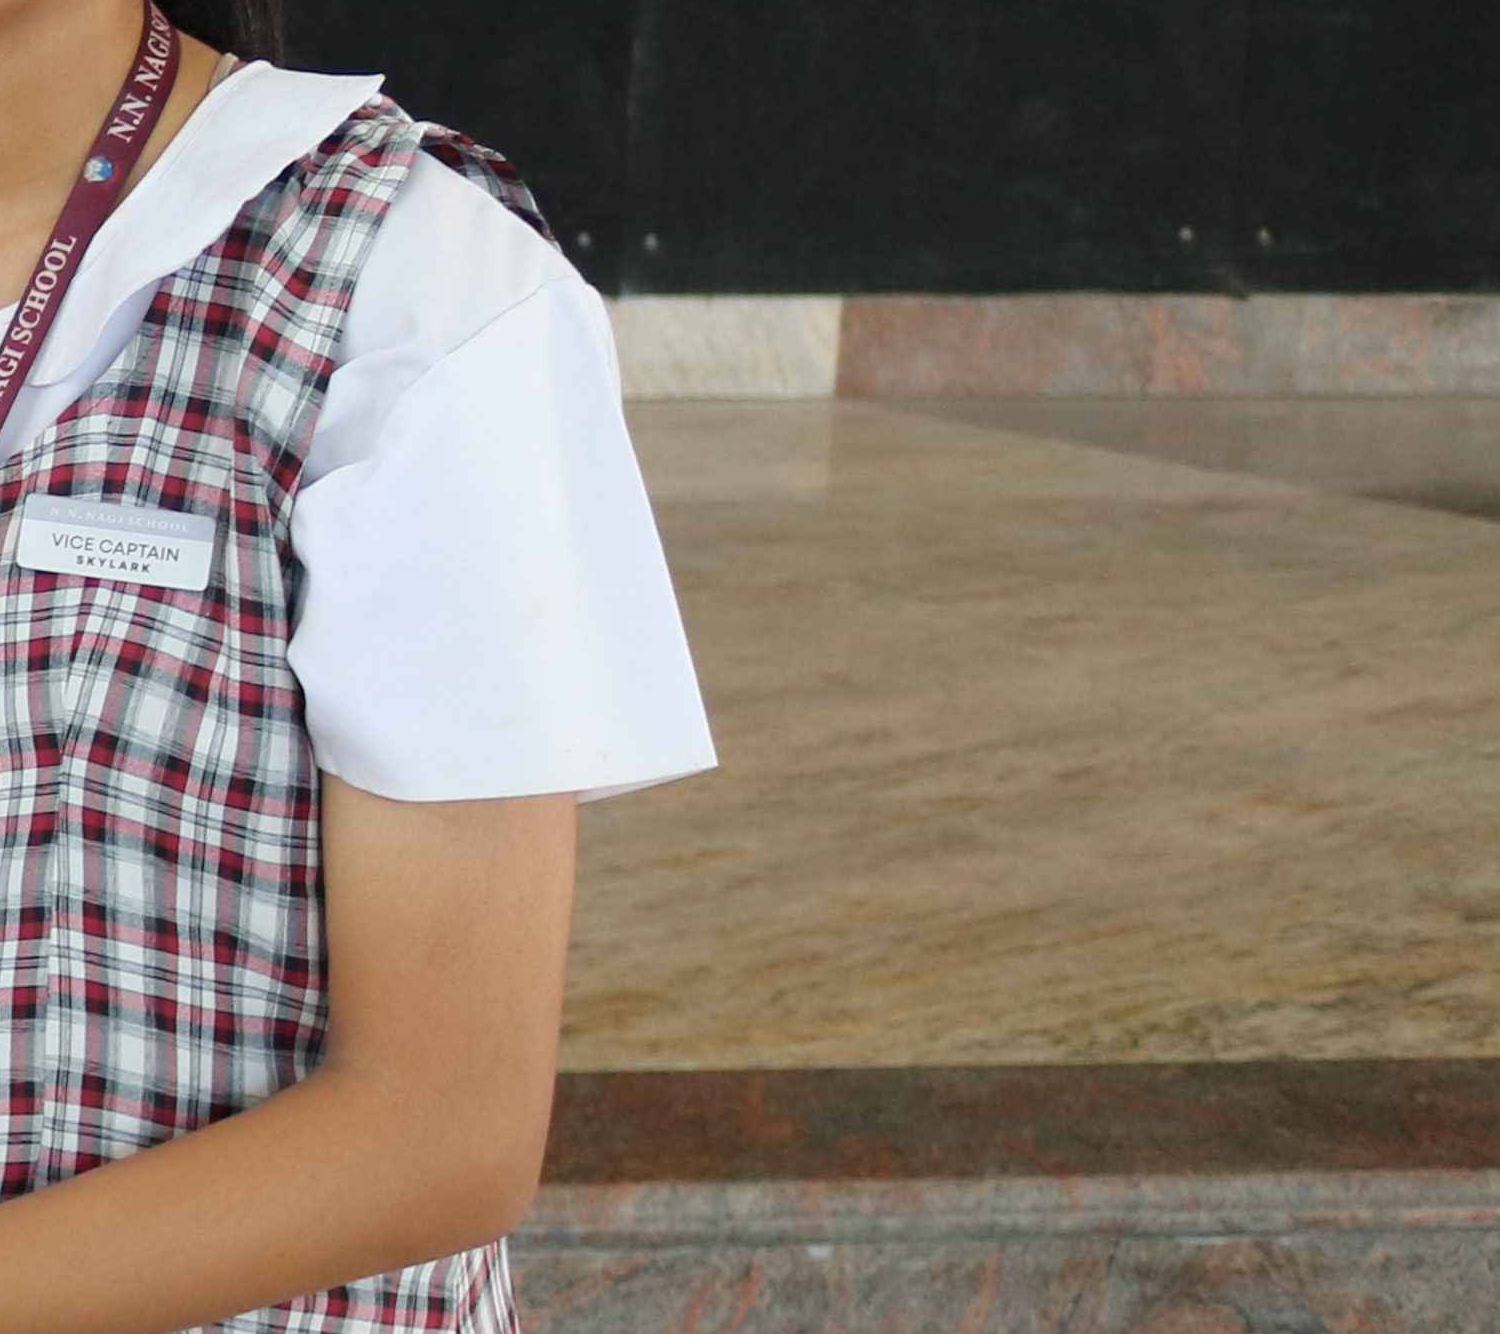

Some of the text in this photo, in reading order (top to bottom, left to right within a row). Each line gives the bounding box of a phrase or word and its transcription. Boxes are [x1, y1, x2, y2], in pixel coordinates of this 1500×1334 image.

[134, 35, 172, 91] NAGI
[11, 235, 78, 345] SCHOOL
[51, 532, 181, 562] VICE CAPTAIN
[76, 555, 151, 573] SKYLARK
